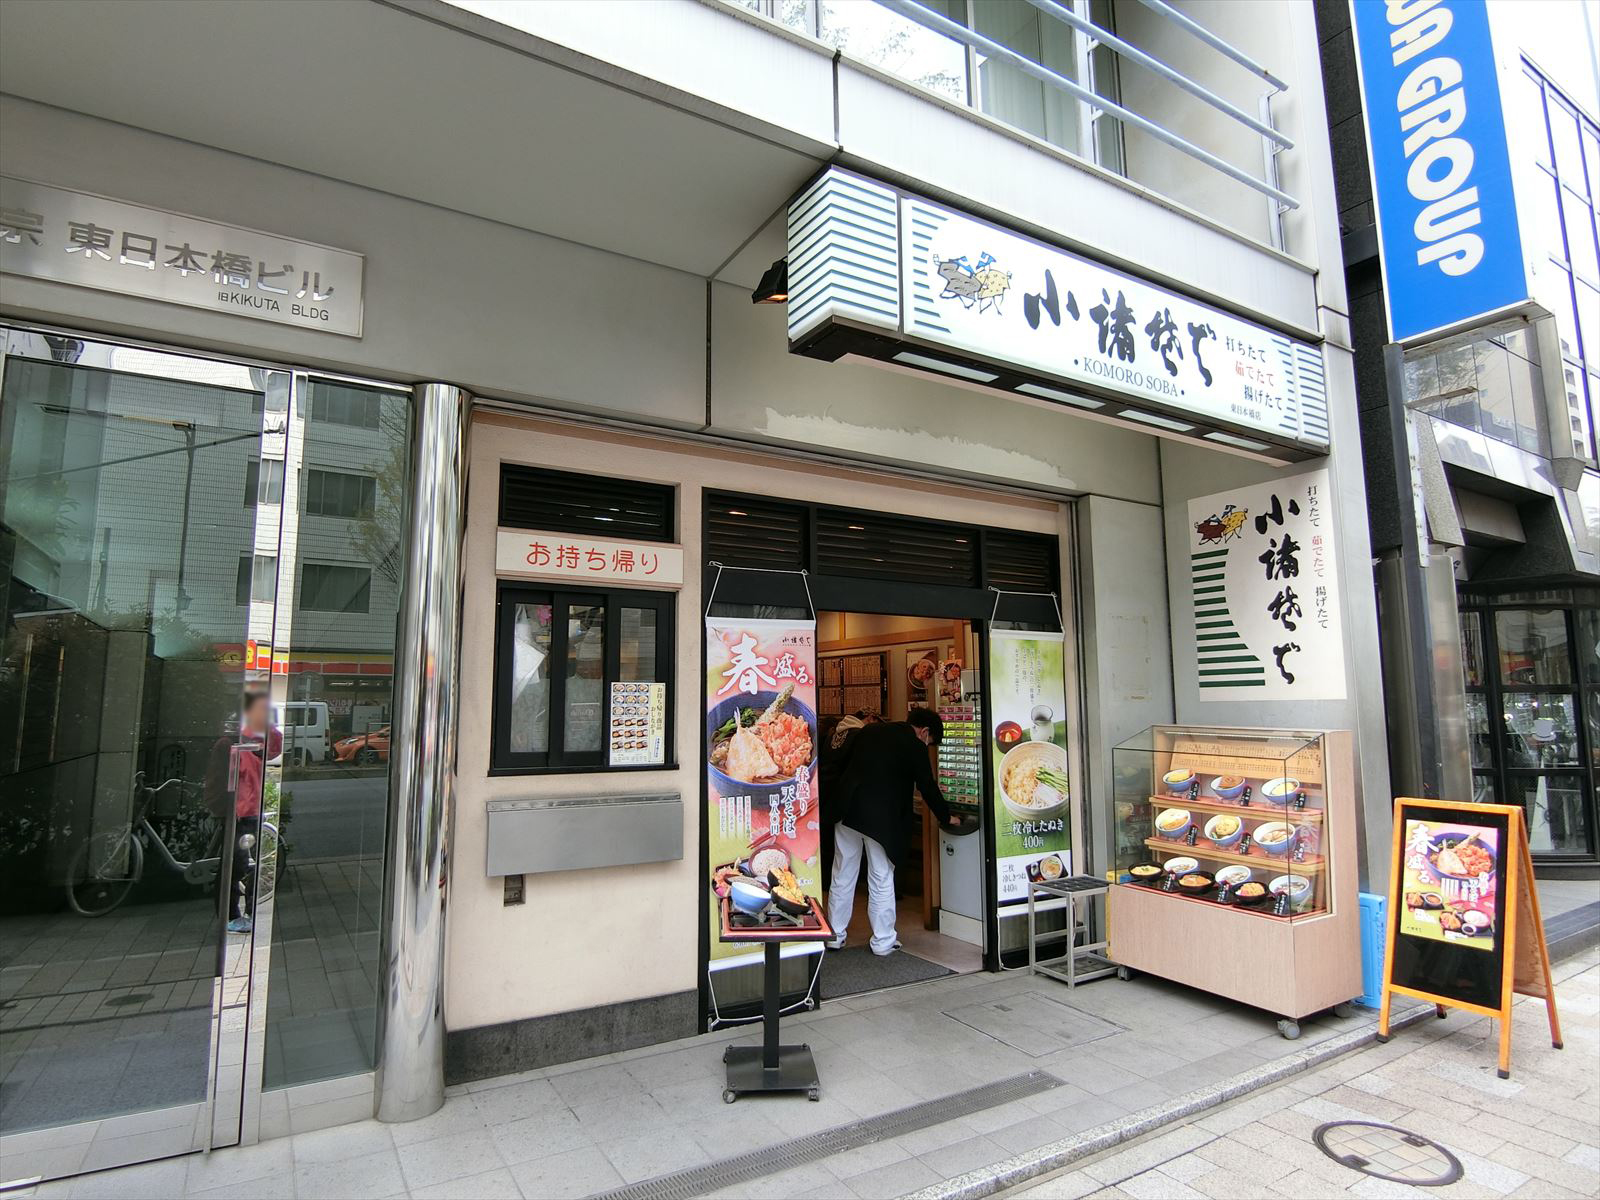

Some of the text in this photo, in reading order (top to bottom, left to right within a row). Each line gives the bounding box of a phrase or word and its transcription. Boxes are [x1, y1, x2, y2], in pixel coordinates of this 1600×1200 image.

[1397, 57, 1484, 276] GROUP
[65, 221, 334, 301] 東日本橋ビル
[291, 304, 329, 321] BLDG
[1226, 336, 1266, 363] 打ちたて
[1084, 357, 1178, 397] KOMORO SOBA
[1235, 360, 1274, 387] 茹でたて
[1244, 384, 1282, 411] 揚げたて
[1230, 402, 1262, 421] 東日本橋店
[526, 541, 659, 575] お持ち帰り
[1307, 485, 1328, 629] 打ちたて 茹でたて 揚げたて
[781, 785, 796, 834] 天そば
[1002, 818, 1063, 837] 二枚冷したぬき
[1023, 835, 1044, 849] 400円
[1002, 863, 1014, 873] 二枚
